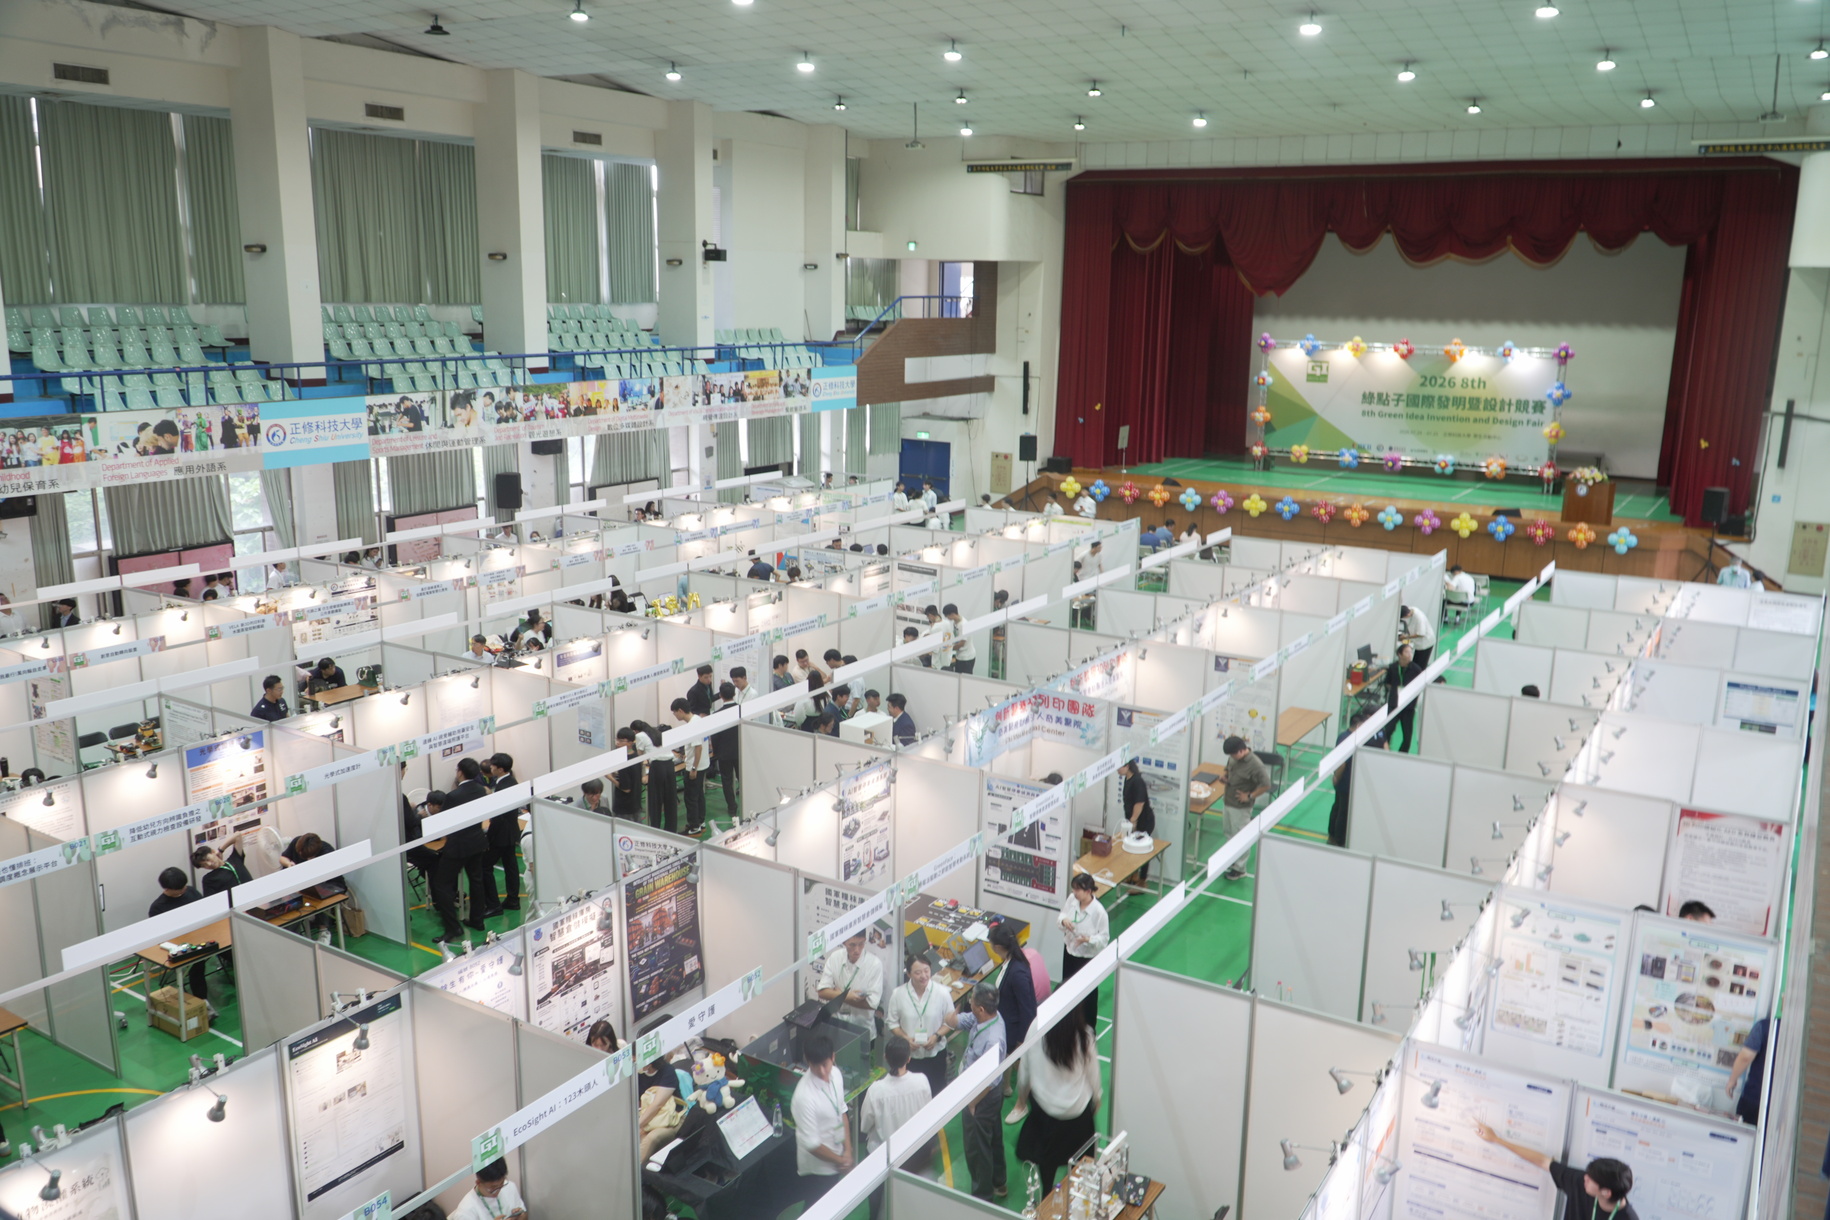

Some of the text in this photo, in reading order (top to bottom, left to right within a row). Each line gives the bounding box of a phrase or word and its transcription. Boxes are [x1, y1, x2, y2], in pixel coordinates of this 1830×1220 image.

[1419, 375, 1487, 390] 2026 8th
[1361, 391, 1547, 415] 綠點子國際發明暨設計競賽
[290, 417, 363, 436] 正修科技大學
[1361, 409, 1545, 428] 8th Green Idea Invention and Design Fair
[289, 431, 364, 445] Cheng Shiu University
[102, 461, 144, 472] Department
[154, 457, 179, 467] Applied
[174, 461, 227, 476] 應用外語系
[103, 470, 168, 482] Foreign Languages
[1041, 726, 1065, 737] Center
[129, 807, 201, 835] 降低幼兒方向辨識負擔之
[130, 815, 202, 843] 互動式視力檢查設備研發
[69, 839, 87, 850] B021
[635, 882, 654, 899] GRAIN
[654, 864, 690, 890] WAREHOUSE
[747, 969, 761, 984] B052
[688, 1003, 716, 1030] 愛守護
[613, 1049, 631, 1065] B053
[513, 1110, 547, 1137] EcoSight
[363, 1195, 388, 1218] B054
